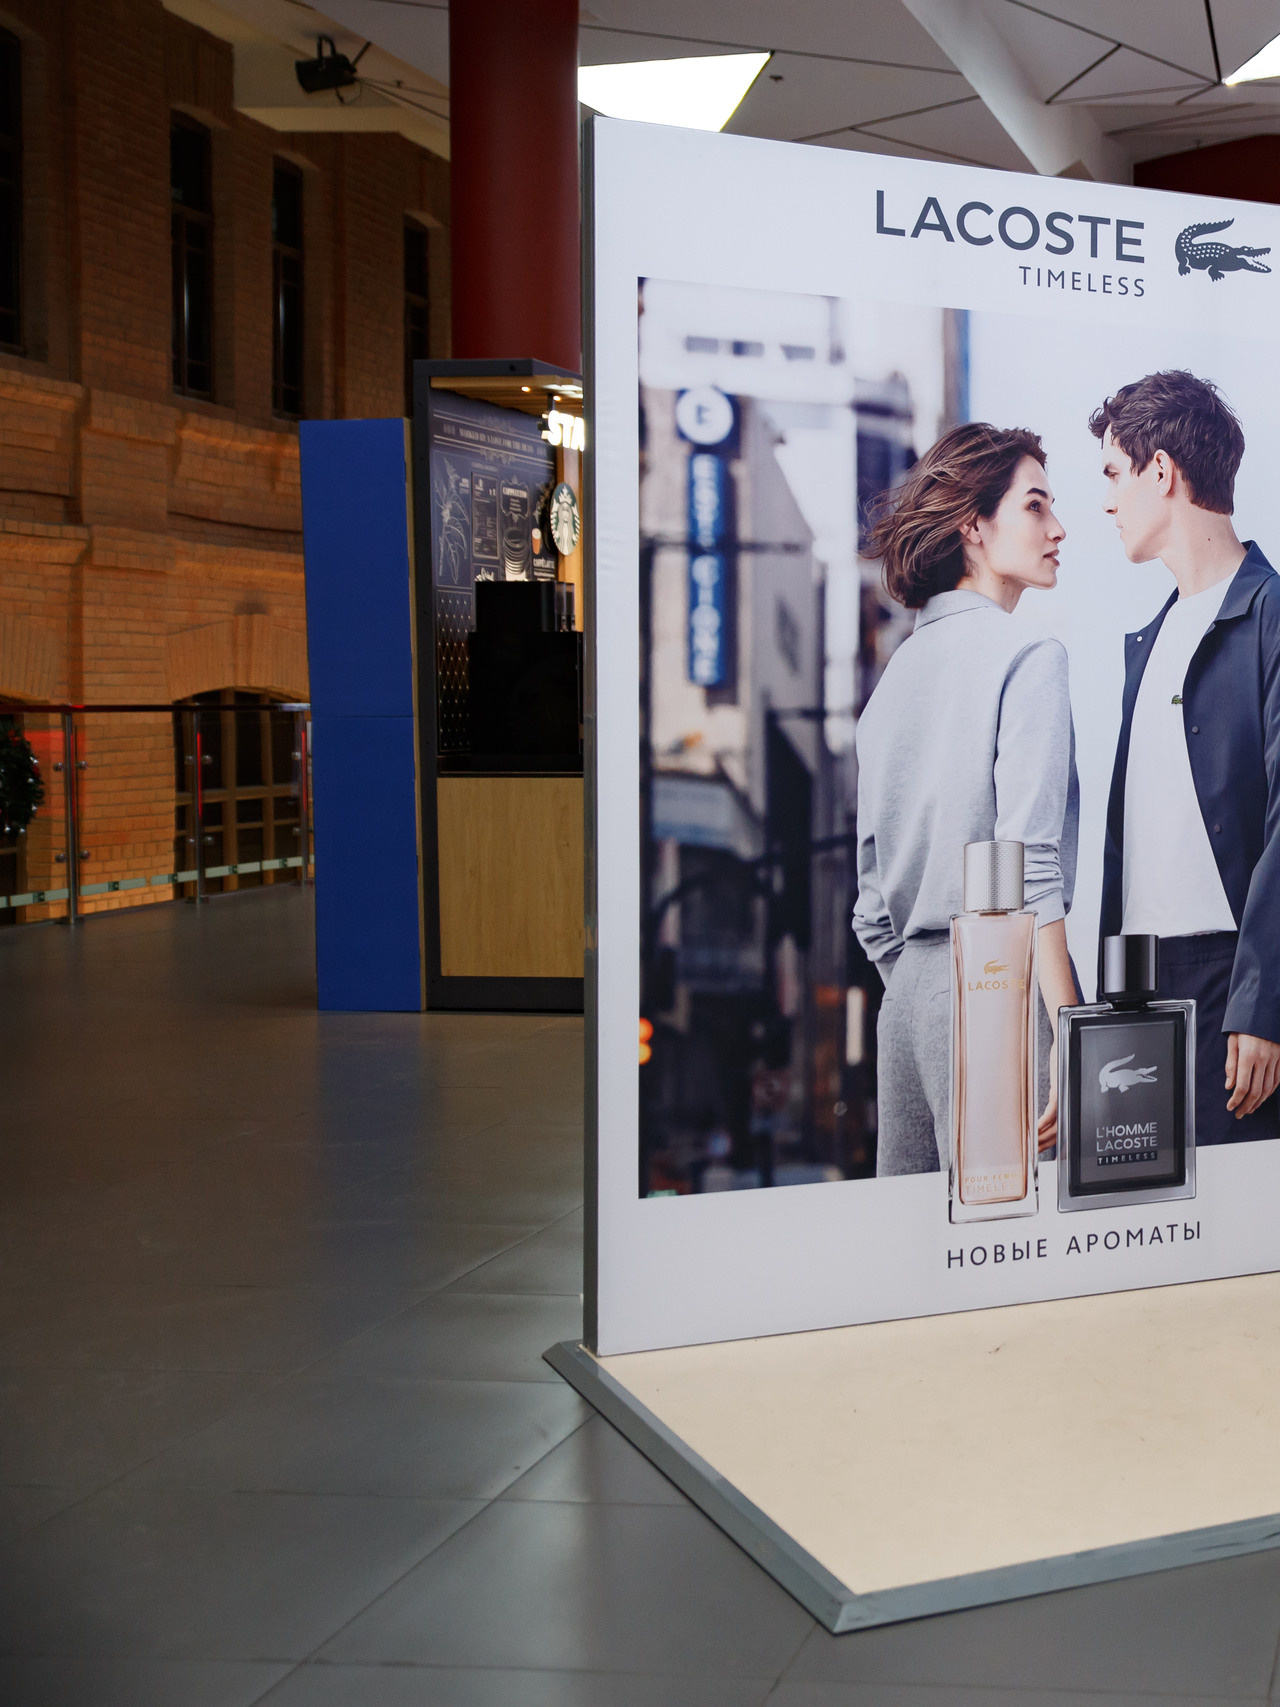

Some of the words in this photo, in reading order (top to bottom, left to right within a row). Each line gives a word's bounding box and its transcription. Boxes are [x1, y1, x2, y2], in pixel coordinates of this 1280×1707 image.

[876, 190, 1145, 263] LACOSTE
[1019, 266, 1145, 297] TIMELESS
[968, 979, 1025, 991] LACOSTE
[1096, 1122, 1157, 1139] L'HOMME
[1096, 1136, 1157, 1152] LACOSTE
[1098, 1153, 1155, 1164] TIMELESS
[948, 1239, 1047, 1268] НОВЫЕ
[1066, 1221, 1200, 1255] АРОМАТЫ
